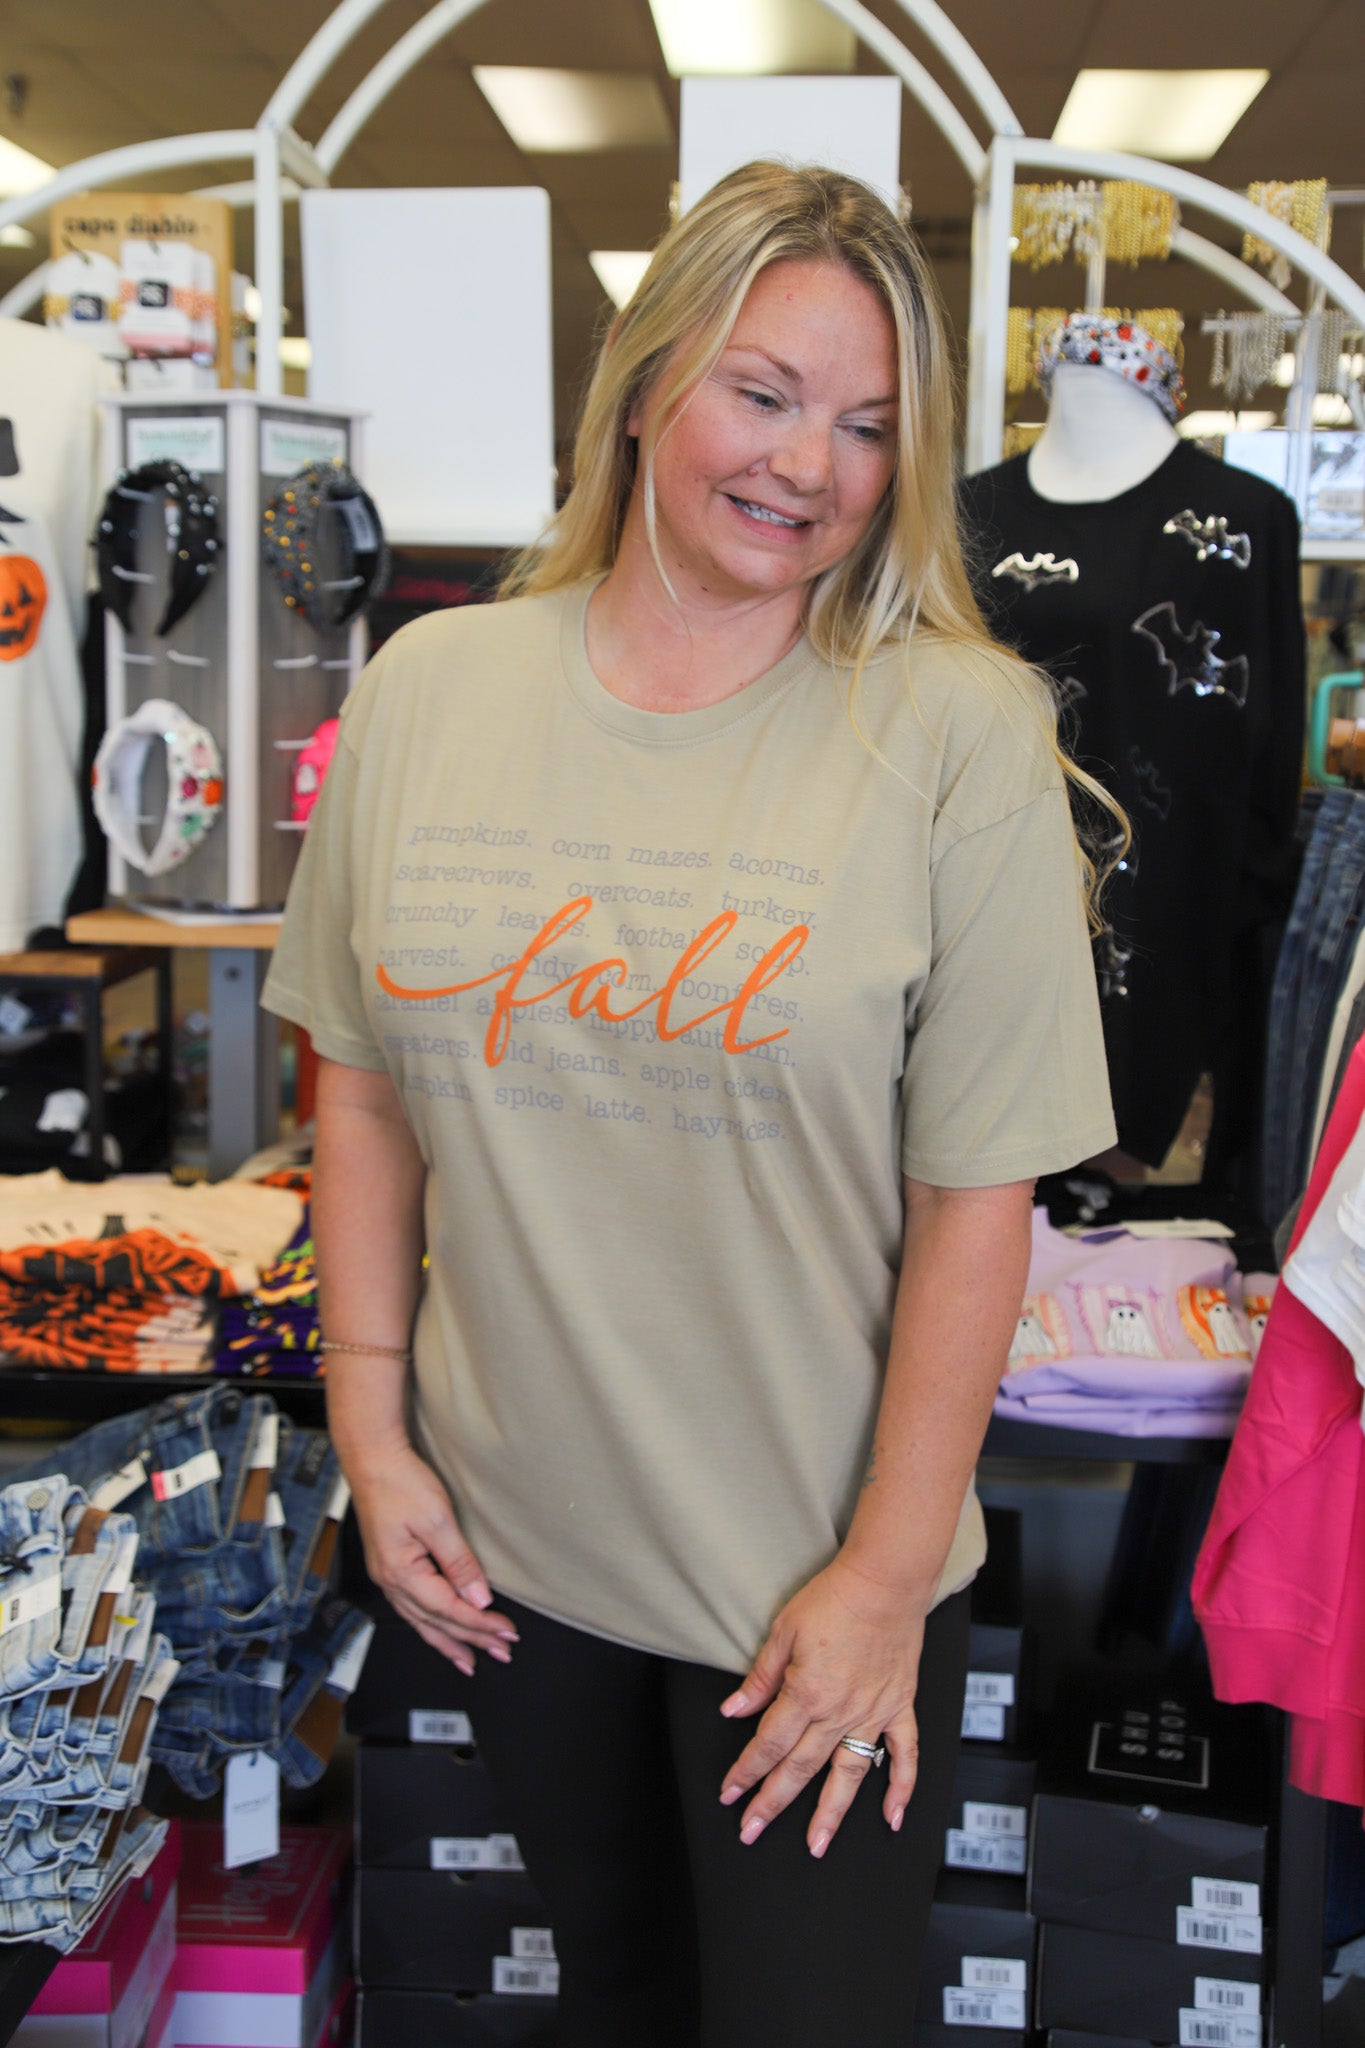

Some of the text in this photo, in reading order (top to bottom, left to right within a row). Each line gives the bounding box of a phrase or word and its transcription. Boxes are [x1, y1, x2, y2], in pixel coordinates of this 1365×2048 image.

[408, 822, 825, 886] pumpkins. corn mazes. acorns.
[395, 863, 817, 930] scarecrows. overcoats. turkey.
[615, 923, 703, 952] footbal.
[375, 895, 810, 1068] fall
[597, 969, 657, 992] corn.
[681, 979, 804, 1022] bonres.
[476, 996, 575, 1023] aples.
[545, 1046, 626, 1078] jeans.
[640, 1062, 711, 1091] apple
[494, 1085, 565, 1111] spice
[584, 1094, 652, 1124] latte.
[673, 1107, 786, 1142] hayrides.
